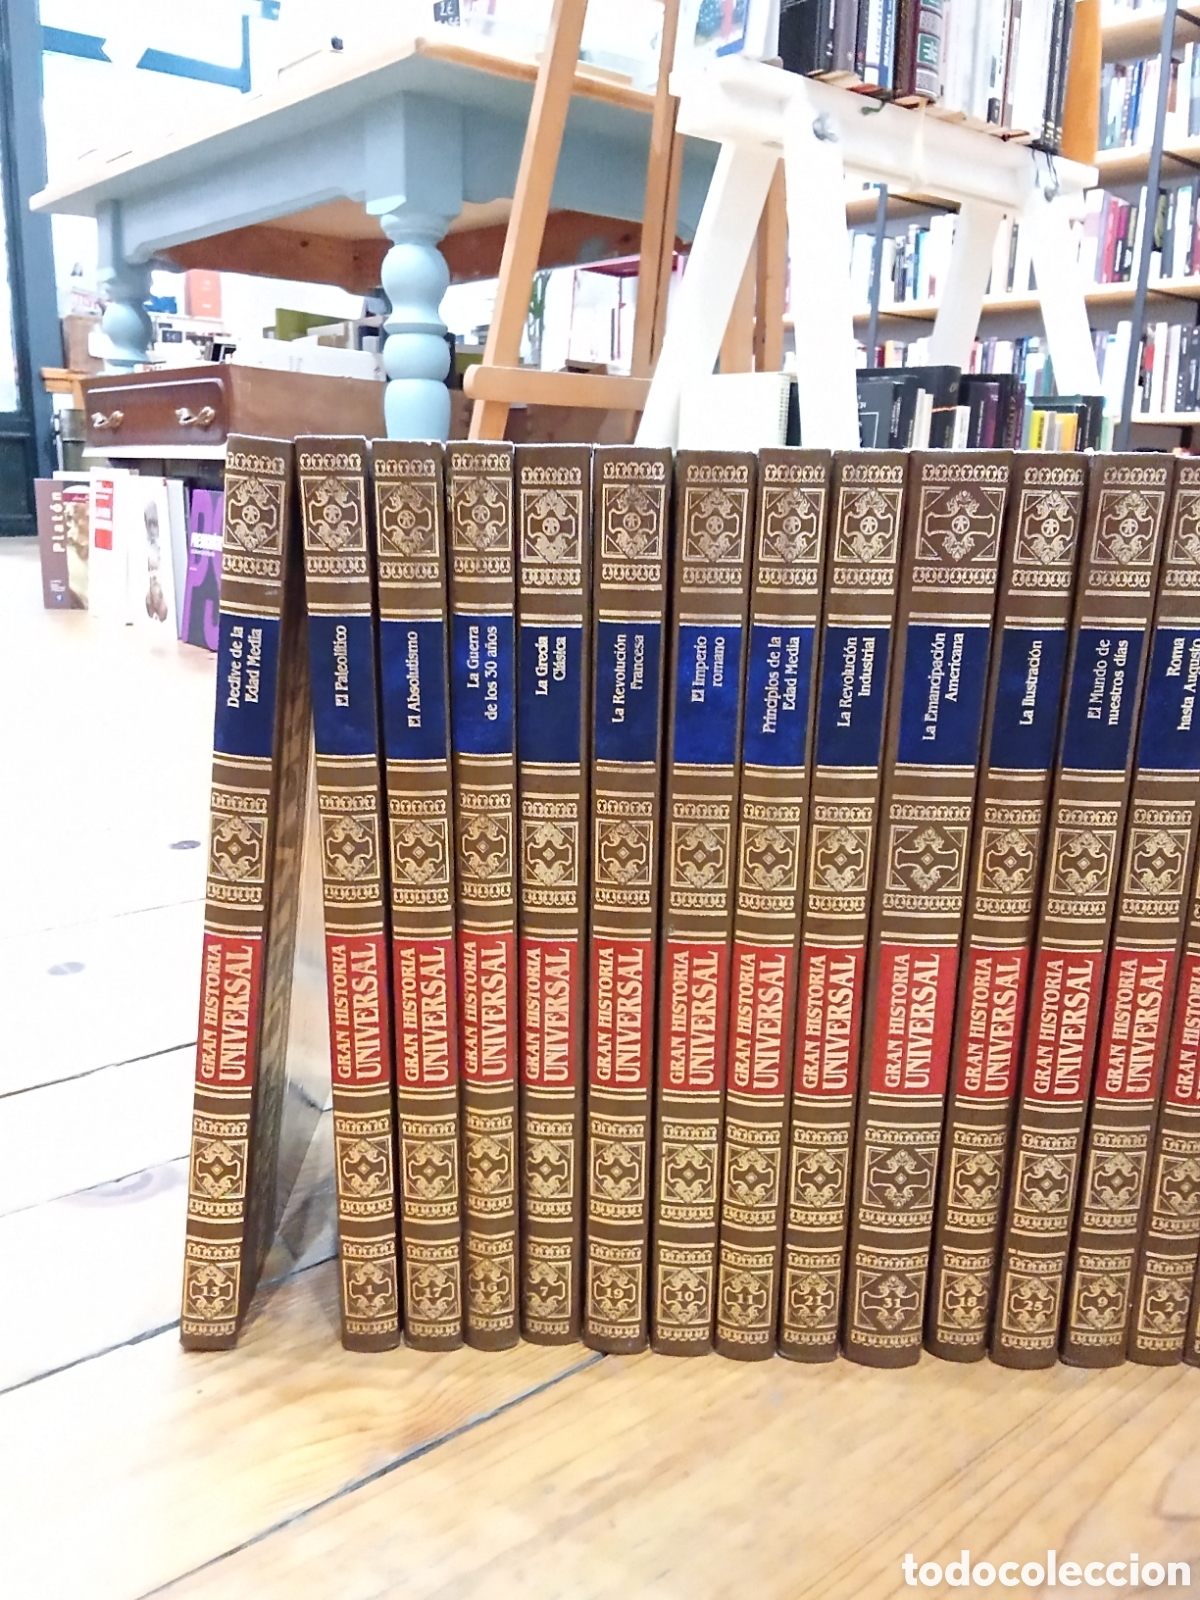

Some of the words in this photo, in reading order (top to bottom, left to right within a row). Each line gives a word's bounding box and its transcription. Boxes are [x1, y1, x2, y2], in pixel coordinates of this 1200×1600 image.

[49, 491, 66, 553] Platón
[230, 641, 244, 658] de
[233, 626, 245, 638] la
[247, 629, 262, 666] Media
[467, 626, 479, 669] Guerra
[485, 626, 497, 657] años
[535, 636, 548, 676] Grecia
[768, 637, 781, 647] la
[785, 637, 799, 674] Media
[1096, 639, 1111, 657] de
[1113, 640, 1128, 666] días
[333, 625, 348, 690] Paleolítico
[405, 631, 420, 712] Absolutismo
[467, 673, 479, 688] La
[485, 661, 497, 678] 30
[553, 637, 566, 681] Clásica
[613, 635, 626, 704] Revolución
[631, 635, 644, 689] Francesa
[692, 636, 709, 686] Imperio
[713, 637, 725, 687] romano
[767, 652, 780, 668] de
[839, 637, 857, 707] Revolución
[858, 637, 875, 696] Industrial
[924, 633, 946, 722] Emancipación
[945, 633, 964, 702] Americana
[1022, 641, 1042, 706] Ilustración
[1166, 638, 1185, 676] Roma
[1184, 638, 1200, 693] Augusto
[227, 661, 243, 708] Declive
[245, 669, 259, 703] Edad
[335, 694, 349, 706] El
[485, 681, 497, 700] los
[535, 680, 548, 695] La
[691, 689, 704, 702] El
[763, 672, 781, 733] Principios
[783, 678, 797, 710] Edad
[1090, 660, 1108, 704] Mundo
[1109, 671, 1124, 725] nuestros
[408, 715, 421, 727] El
[485, 704, 497, 720] de
[612, 708, 624, 722] La
[837, 712, 851, 726] La
[923, 726, 936, 740] La
[1020, 710, 1033, 724] La
[1087, 707, 1101, 719] El
[1177, 697, 1194, 730] hasta
[204, 944, 222, 1026] HISTORIA
[332, 945, 349, 1026] HISTORIA
[400, 948, 417, 1029] HISTORIA
[464, 942, 477, 1022] HISTORIA
[527, 948, 541, 1028] HISTORIA
[598, 948, 613, 1028] HISTORIA
[671, 951, 689, 1032] HISTORIA
[737, 954, 756, 1035] HISTORIA
[806, 955, 826, 1036] HISTORIA
[889, 954, 910, 1035] HISTORIA
[969, 958, 992, 1038] HISTORIA
[1039, 960, 1063, 1041] HISTORIA
[1112, 959, 1138, 1040] HISTORIA
[219, 946, 252, 1081] UNIVERSAL
[351, 943, 382, 1080] UNIVERSAL
[420, 947, 449, 1083] UNIVERSAL
[481, 941, 508, 1077] UNIVERSAL
[544, 948, 572, 1082] UNIVERSAL
[616, 948, 643, 1082] UNIVERSAL
[689, 951, 718, 1086] UNIVERSAL
[753, 954, 786, 1089] UNIVERSAL
[823, 955, 856, 1090] UNIVERSAL
[905, 954, 939, 1089] UNIVERSAL
[985, 957, 1021, 1093] UNIVERSAL
[1054, 960, 1093, 1096] UNIVERSAL
[1126, 959, 1167, 1094] UNIVERSAL
[201, 1029, 217, 1079] GRAN
[336, 1030, 351, 1079] GRAN
[403, 1033, 419, 1082] GRAN
[465, 1026, 478, 1075] GRAN
[526, 1032, 540, 1079] GRAN
[597, 1032, 612, 1080] GRAN
[670, 1036, 686, 1084] GRAN
[732, 1037, 751, 1087] GRAN
[803, 1040, 820, 1088] GRAN
[885, 1040, 903, 1087] GRAN
[965, 1043, 984, 1090] GRAN
[1034, 1045, 1053, 1093] GRAN
[1106, 1044, 1126, 1092] GRAN
[1175, 1050, 1197, 1098] GRAN
[203, 1287, 220, 1298] 13
[366, 1285, 374, 1295] 1
[424, 1287, 443, 1298] 17
[479, 1281, 499, 1292] 16
[540, 1285, 549, 1297] 7
[605, 1287, 624, 1299] 19
[675, 1291, 695, 1302] 10
[738, 1293, 754, 1305] 11
[804, 1295, 822, 1306] 21
[883, 1297, 902, 1309] 31
[958, 1297, 978, 1308] 18
[1023, 1300, 1044, 1312] 25
[1097, 1297, 1107, 1308] 9
[1165, 1302, 1175, 1312] 2
